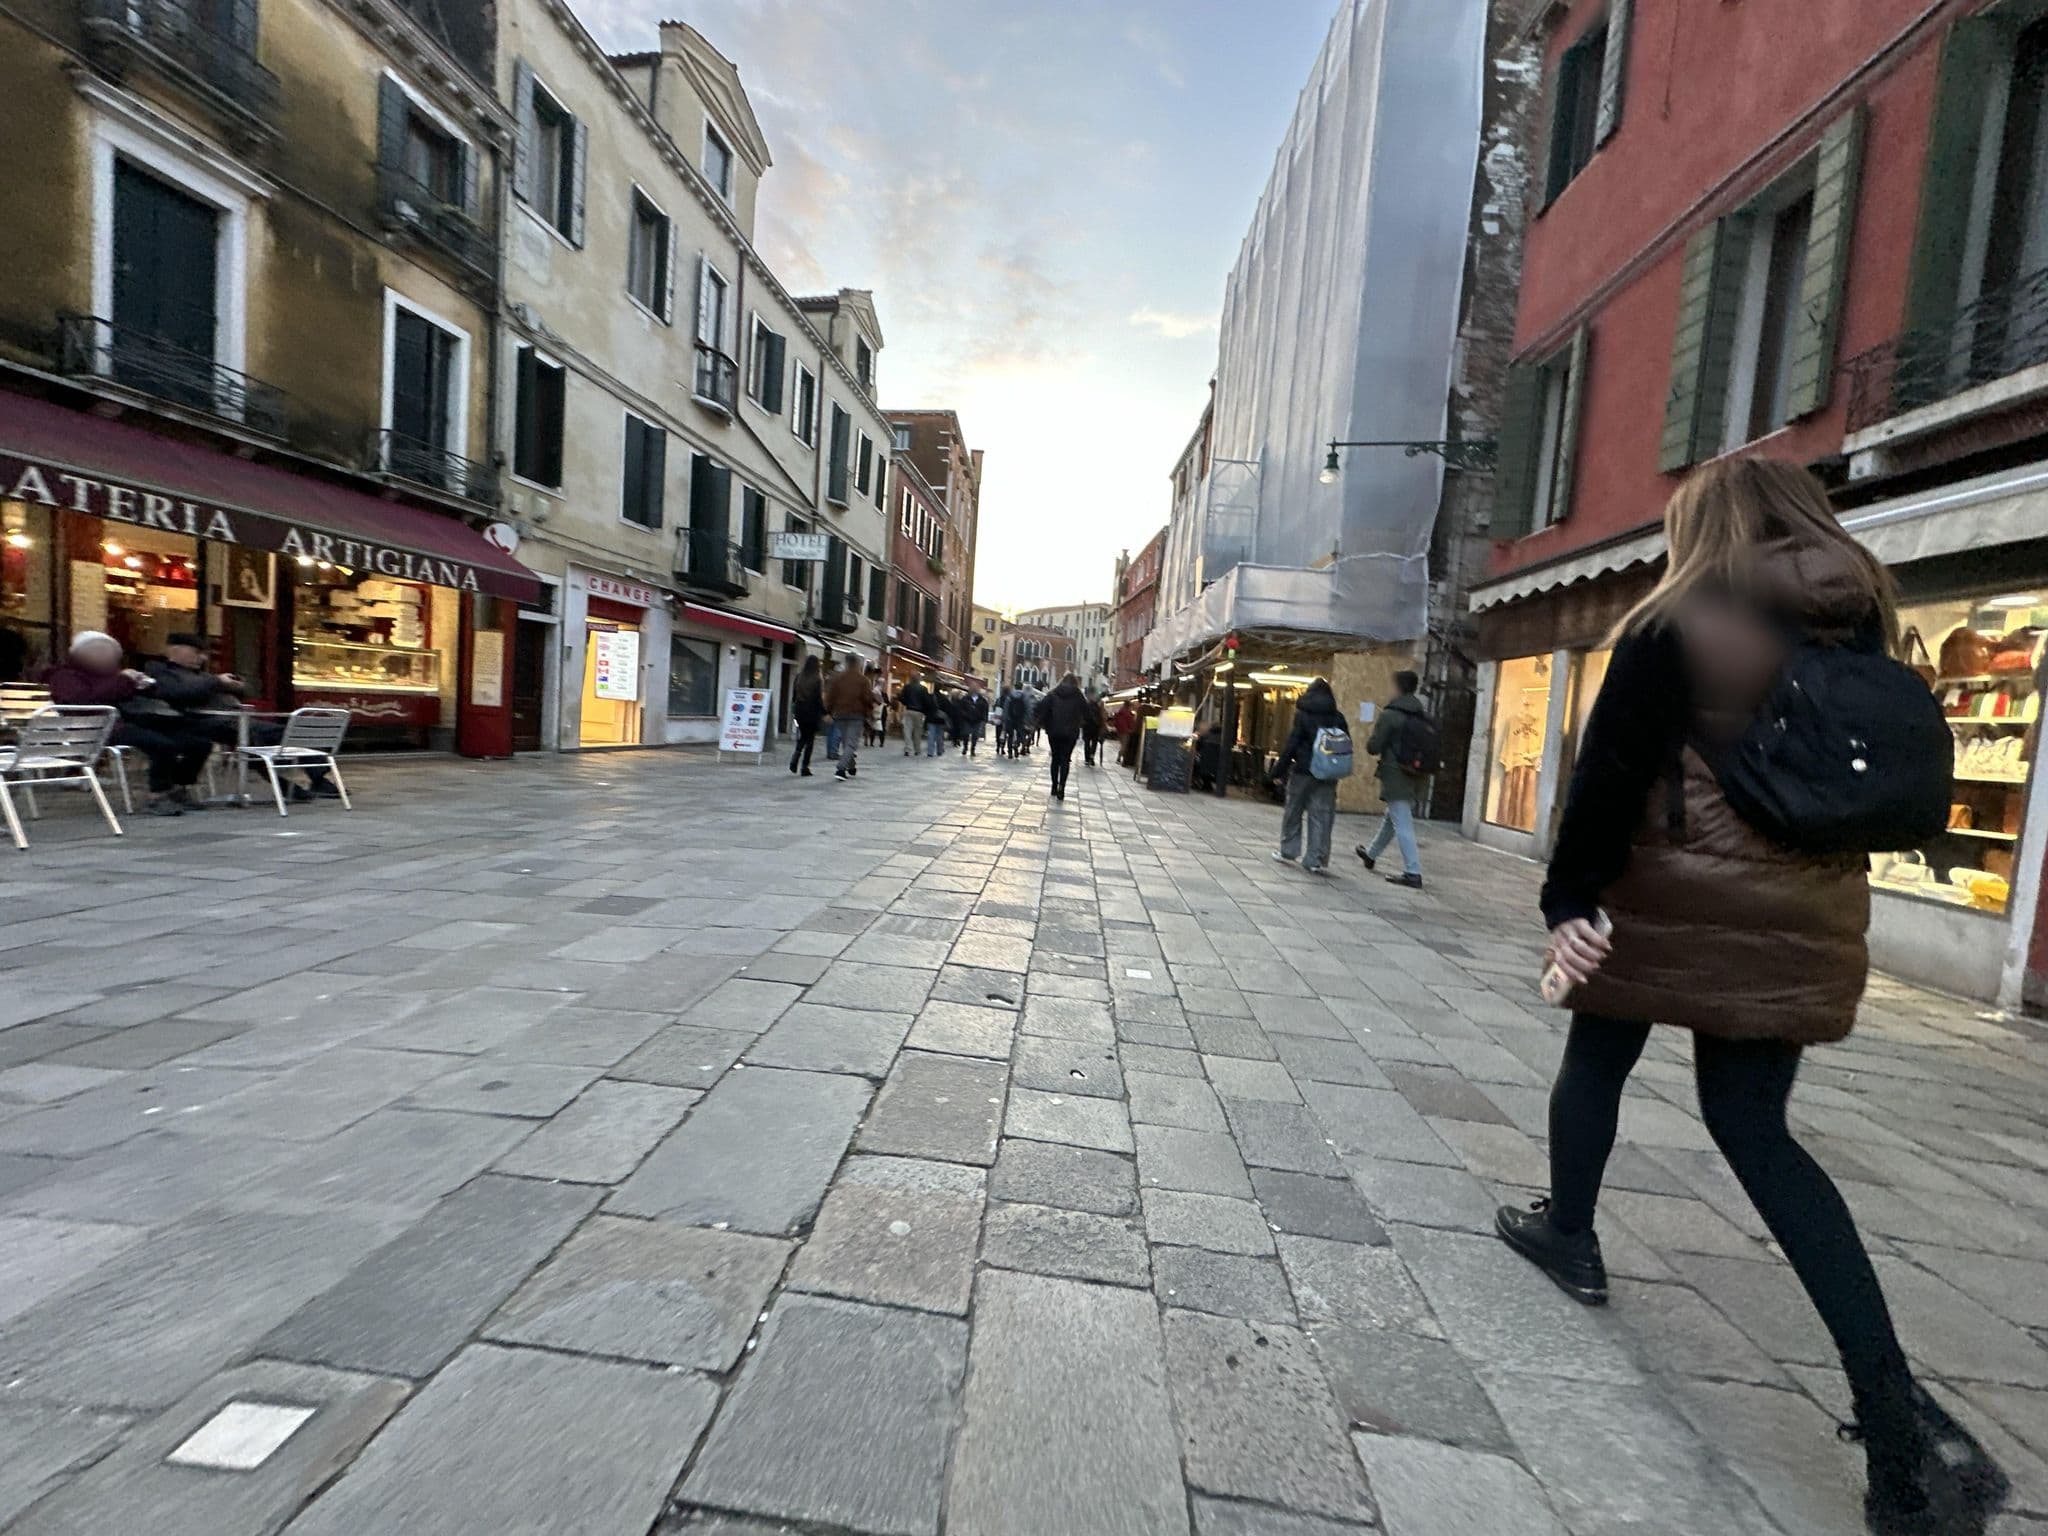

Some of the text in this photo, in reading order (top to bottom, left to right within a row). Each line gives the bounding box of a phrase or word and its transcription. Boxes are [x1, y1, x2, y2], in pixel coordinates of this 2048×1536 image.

[0, 465, 480, 592] ATERIA ARTIGIANA
[774, 533, 825, 548] HOTEL
[589, 577, 651, 602] CHANGE
